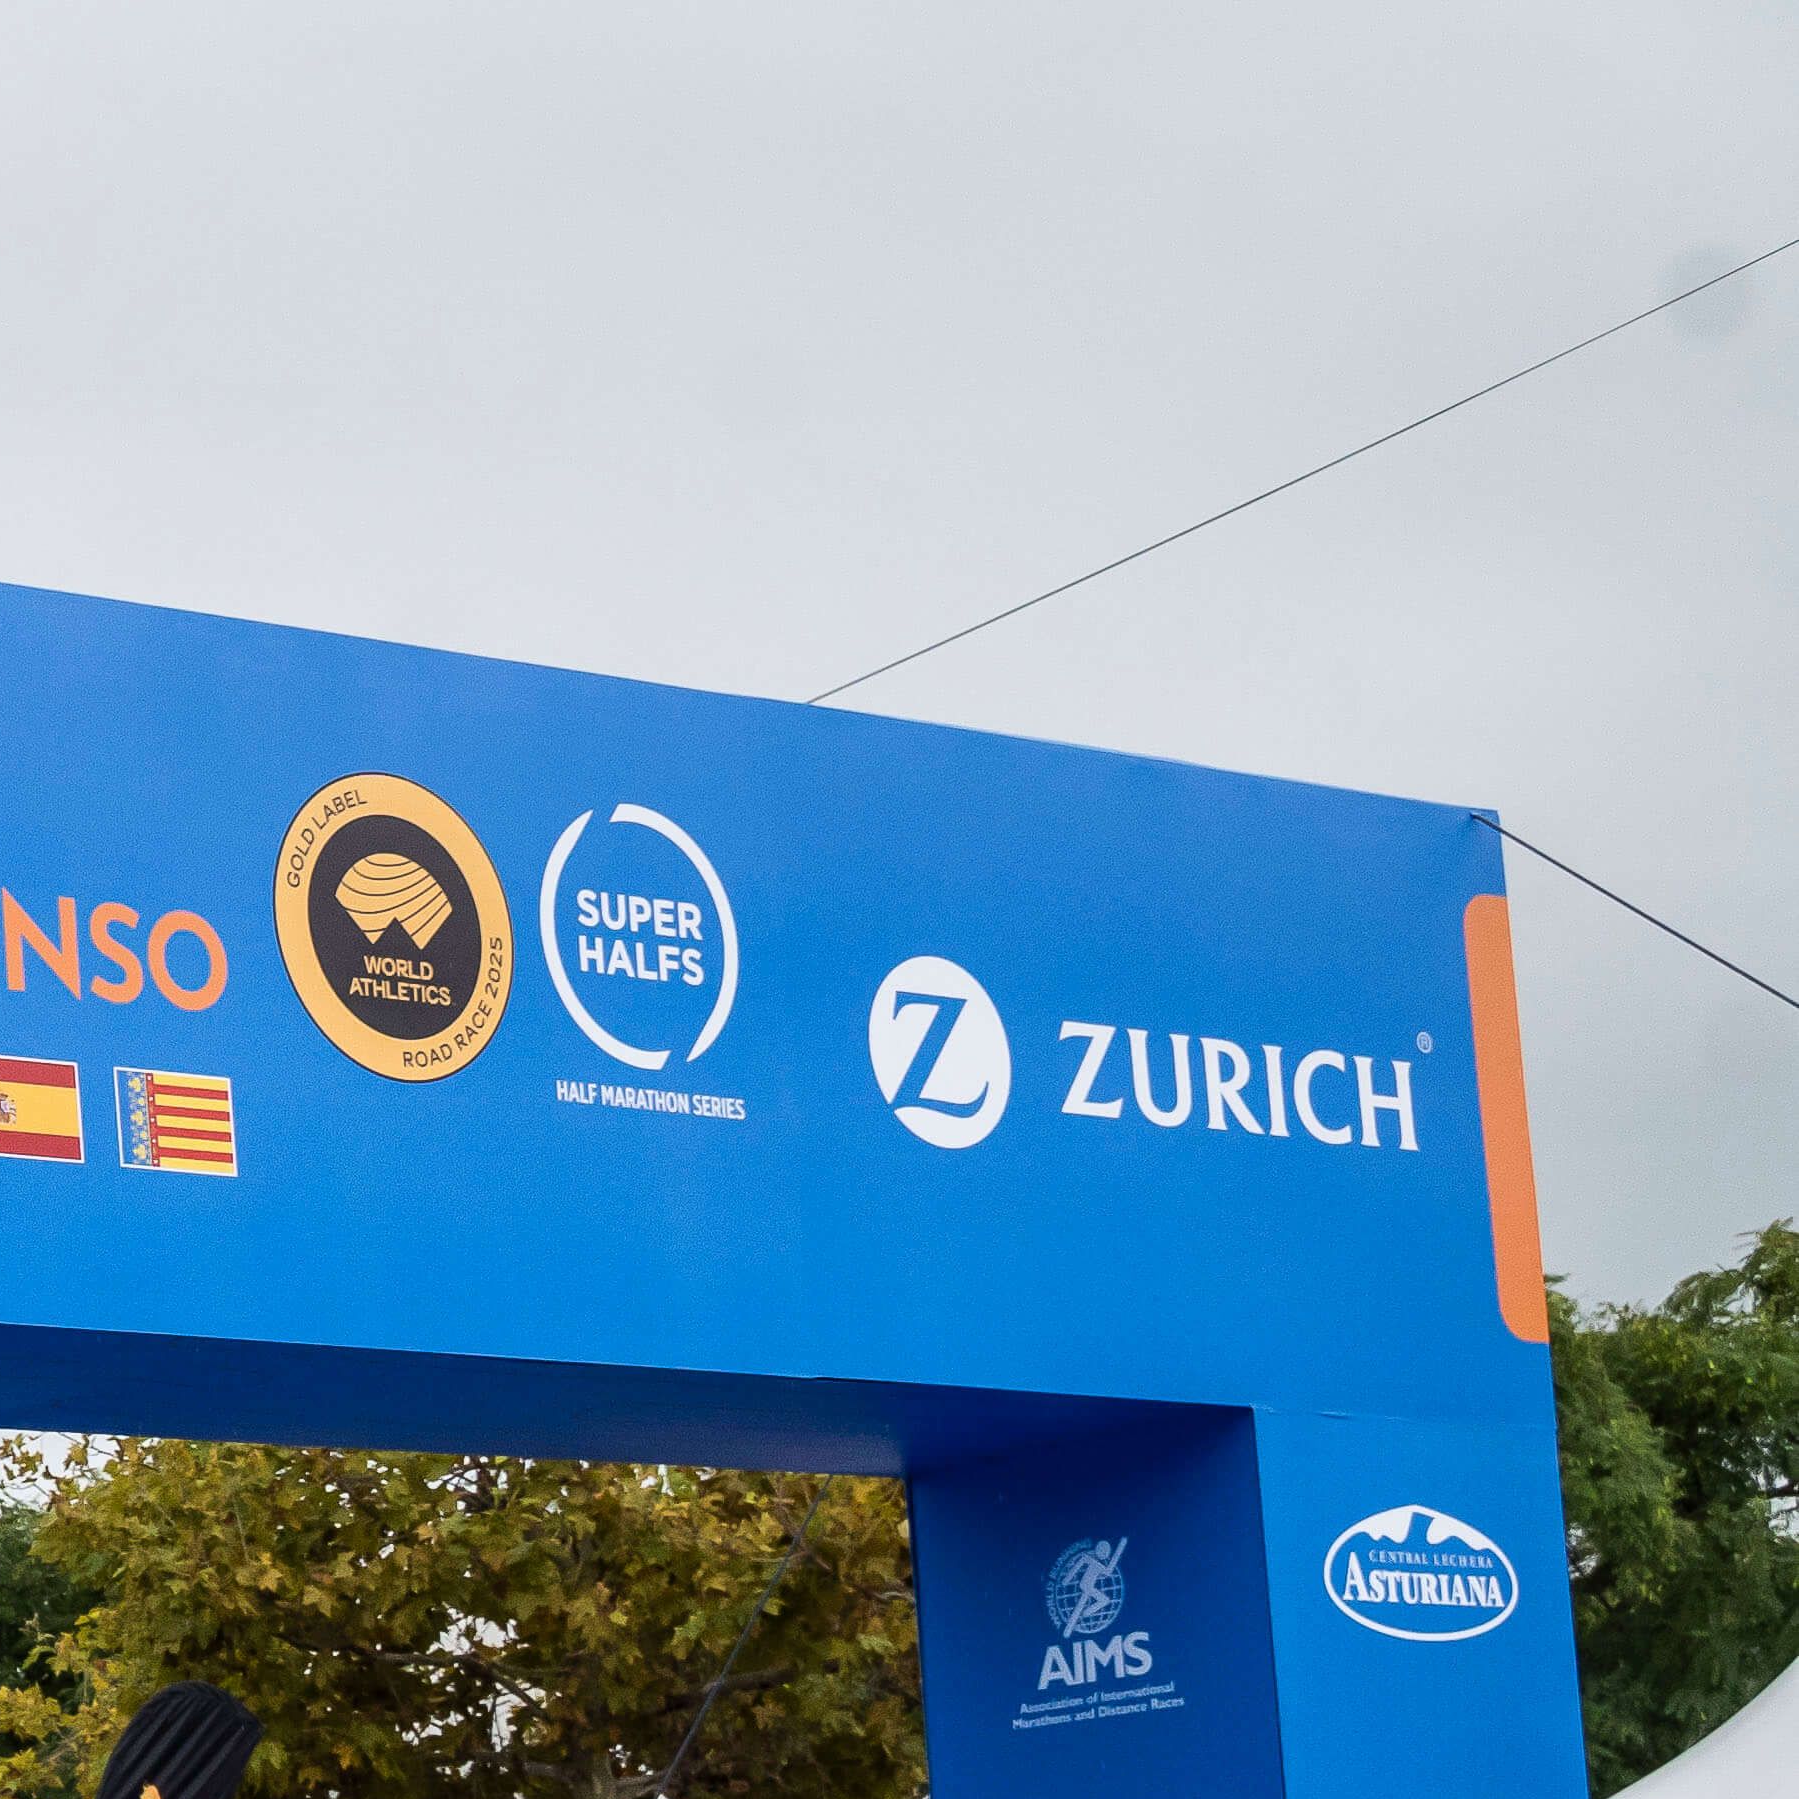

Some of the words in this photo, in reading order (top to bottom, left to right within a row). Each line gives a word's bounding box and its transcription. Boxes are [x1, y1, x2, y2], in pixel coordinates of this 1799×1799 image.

[287, 827, 315, 888] GOLD
[313, 789, 367, 830] LABEL
[576, 889, 703, 942] SUPER
[364, 954, 434, 981] WORLD
[579, 934, 704, 986] HALFS
[349, 976, 452, 1007] ATHLETICS
[403, 1044, 454, 1068] ROAD
[452, 1004, 492, 1052] RACE
[487, 936, 503, 1000] 2025
[556, 1080, 598, 1105] HALF
[600, 1084, 691, 1115] MARATHON
[692, 1093, 746, 1120] SERIES
[1059, 1020, 1419, 1152] ZURICH
[1342, 1551, 1505, 1608] ASTURIANA
[1368, 1549, 1429, 1565] CENTRAL
[1433, 1553, 1494, 1569] LECHERA
[1037, 1631, 1153, 1690] AIMS
